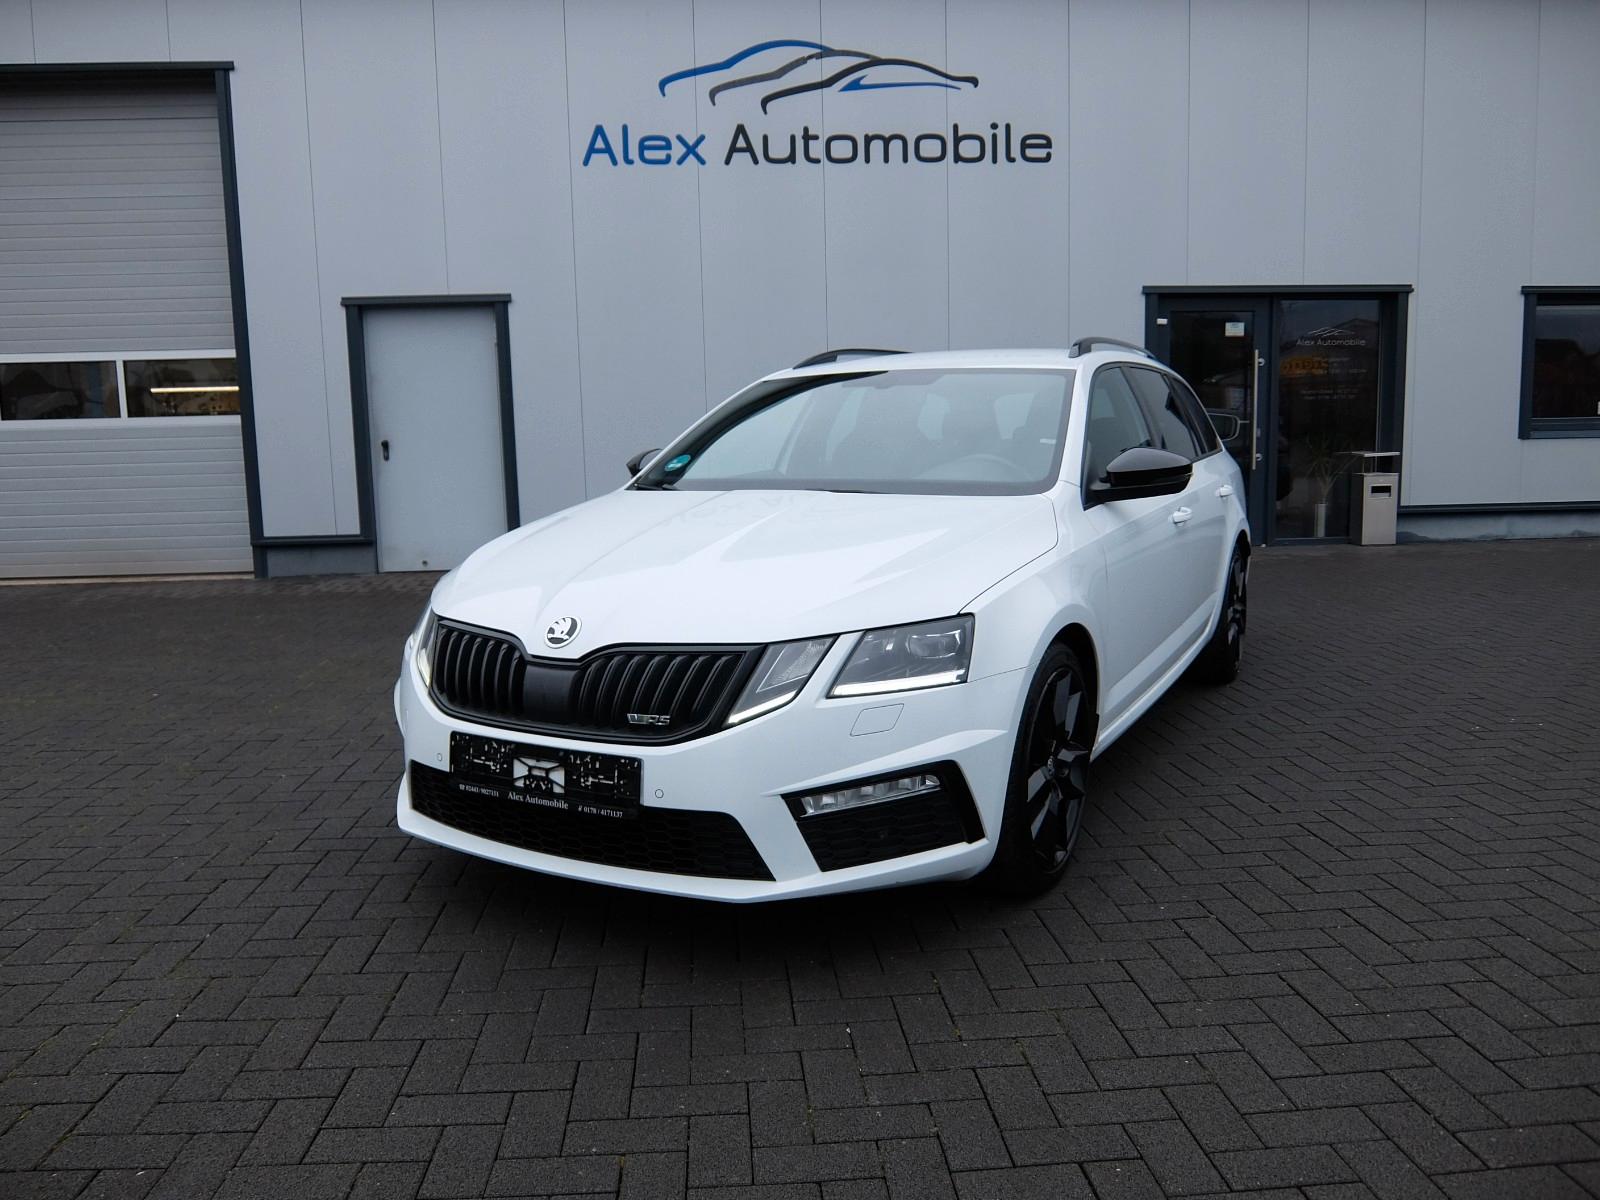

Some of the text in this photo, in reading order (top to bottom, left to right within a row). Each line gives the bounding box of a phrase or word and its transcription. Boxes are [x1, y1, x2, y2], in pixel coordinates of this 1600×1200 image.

[582, 122, 1053, 167] Alex Automobile
[1296, 337, 1366, 346] Alex Automobile
[507, 791, 569, 810] Alex Automobile
